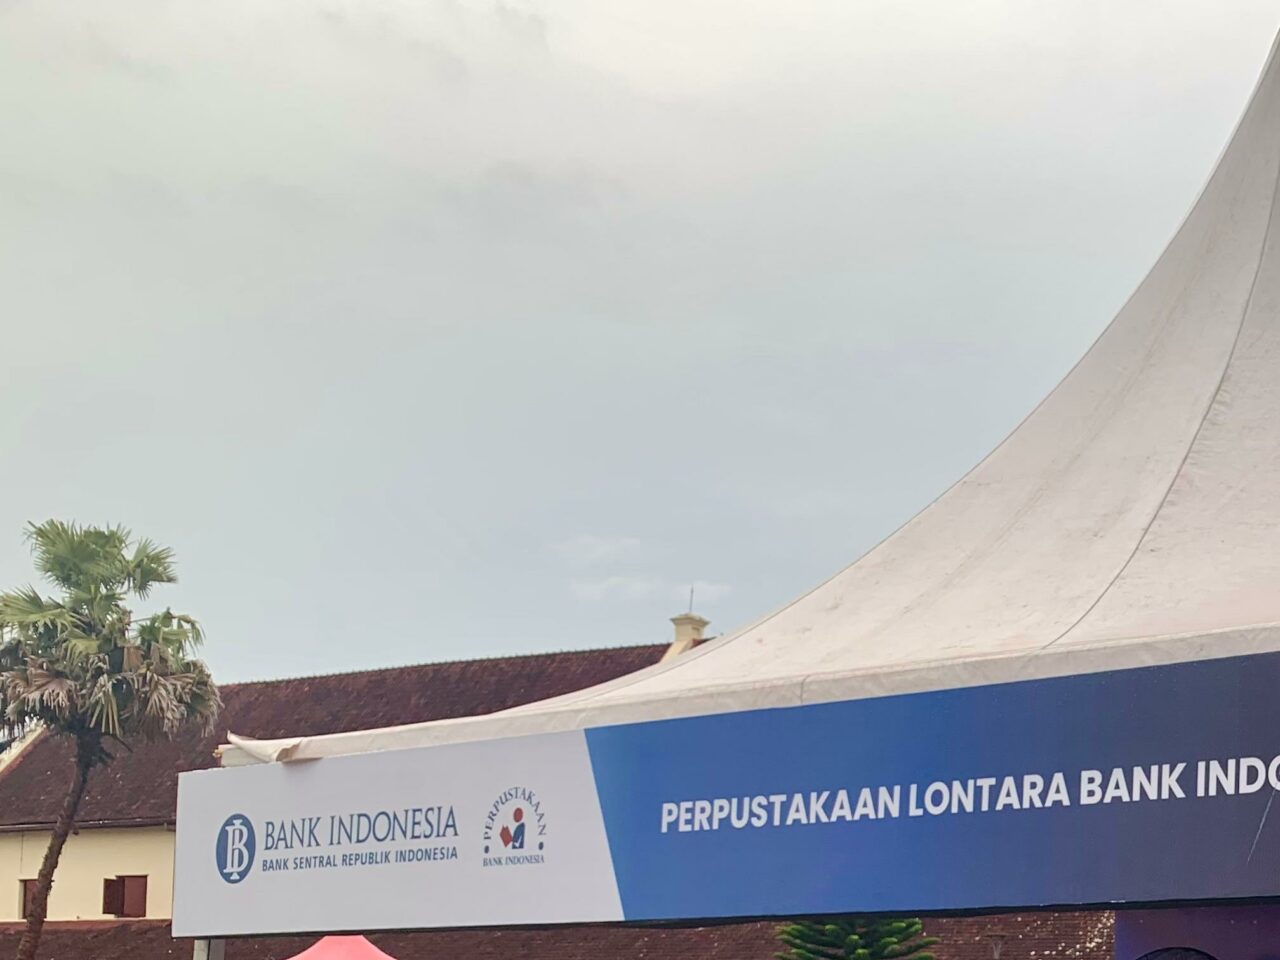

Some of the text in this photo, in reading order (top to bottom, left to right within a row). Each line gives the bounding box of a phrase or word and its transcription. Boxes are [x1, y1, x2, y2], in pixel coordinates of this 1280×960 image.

[483, 786, 547, 840] PERPUSTAKAAN
[661, 784, 900, 833] PERPUSTAKAAN
[909, 772, 1070, 817] LONTARA
[1079, 762, 1187, 804] BANK
[264, 805, 459, 851] BANK INDONESIA
[262, 846, 458, 872] BANK SENTRAL REPUBLIK INDONESIA
[483, 854, 545, 867] BANK INDONESIA
